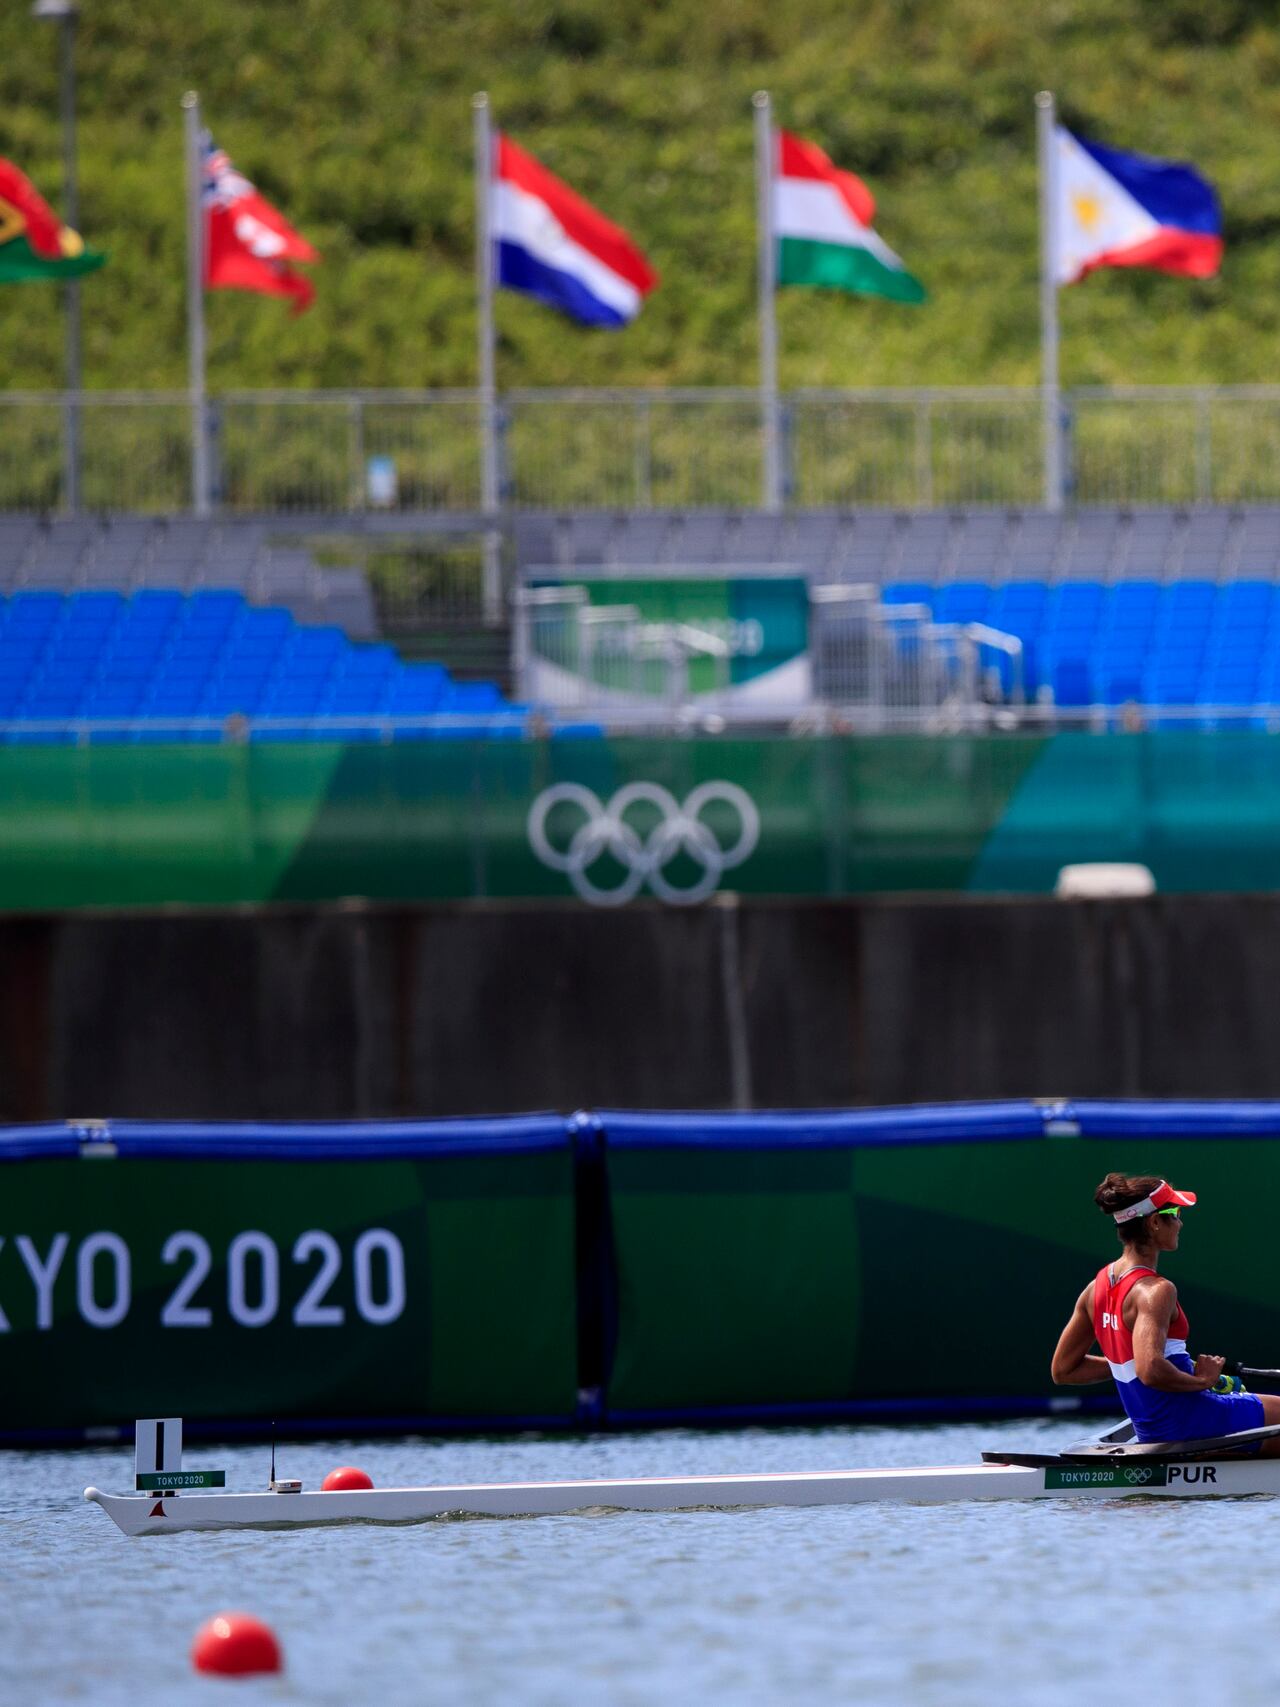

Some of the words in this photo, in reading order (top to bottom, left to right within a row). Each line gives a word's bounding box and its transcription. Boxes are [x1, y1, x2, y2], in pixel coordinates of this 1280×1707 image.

[0, 1231, 131, 1331] YO
[161, 1228, 406, 1327] 2020
[157, 1477, 183, 1485] TOKYO
[185, 1475, 204, 1484] 2020
[1061, 1472, 1090, 1482] TOKYO
[1092, 1471, 1114, 1481] 2020
[1168, 1466, 1217, 1483] PUR
